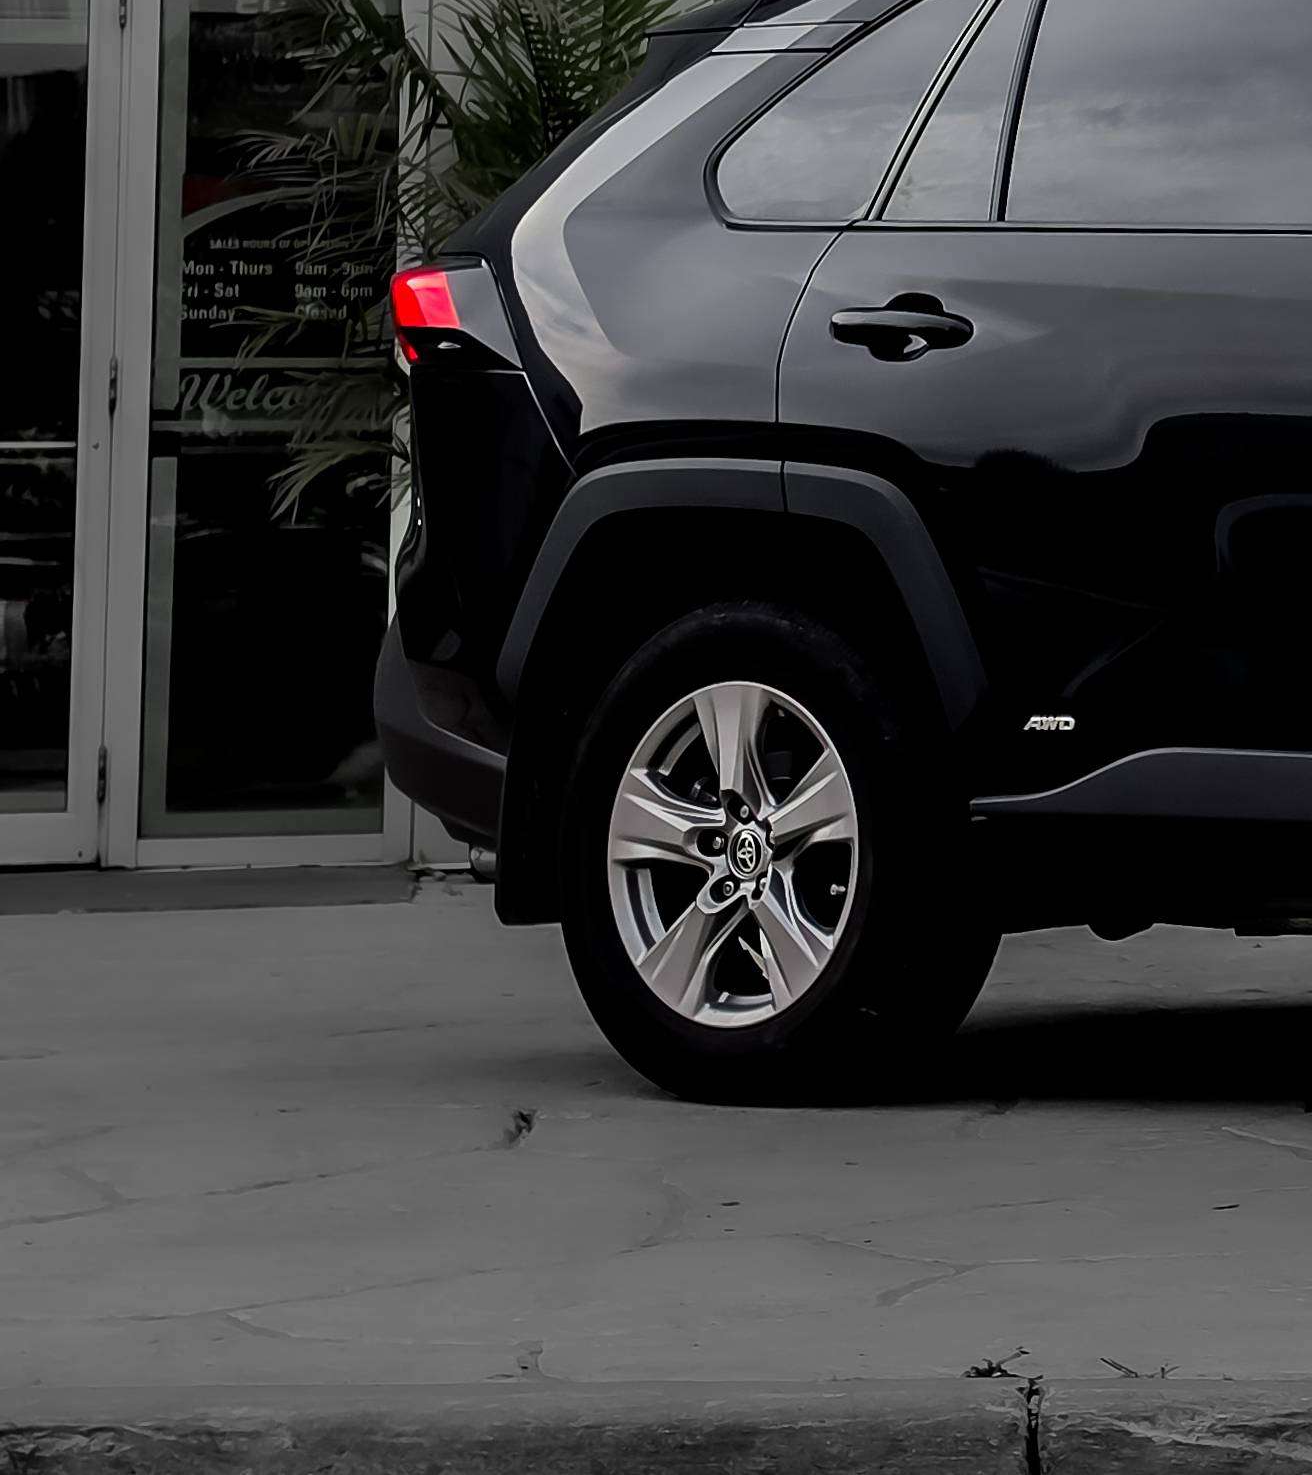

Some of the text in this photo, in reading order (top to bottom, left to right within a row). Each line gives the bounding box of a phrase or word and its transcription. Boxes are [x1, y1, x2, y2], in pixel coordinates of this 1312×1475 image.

[228, 260, 273, 276] Thurs
[295, 260, 327, 276] 9am
[213, 281, 240, 298] Sat
[294, 282, 327, 299] 9am
[340, 282, 373, 301] 6pm
[1022, 715, 1076, 731] AWD
